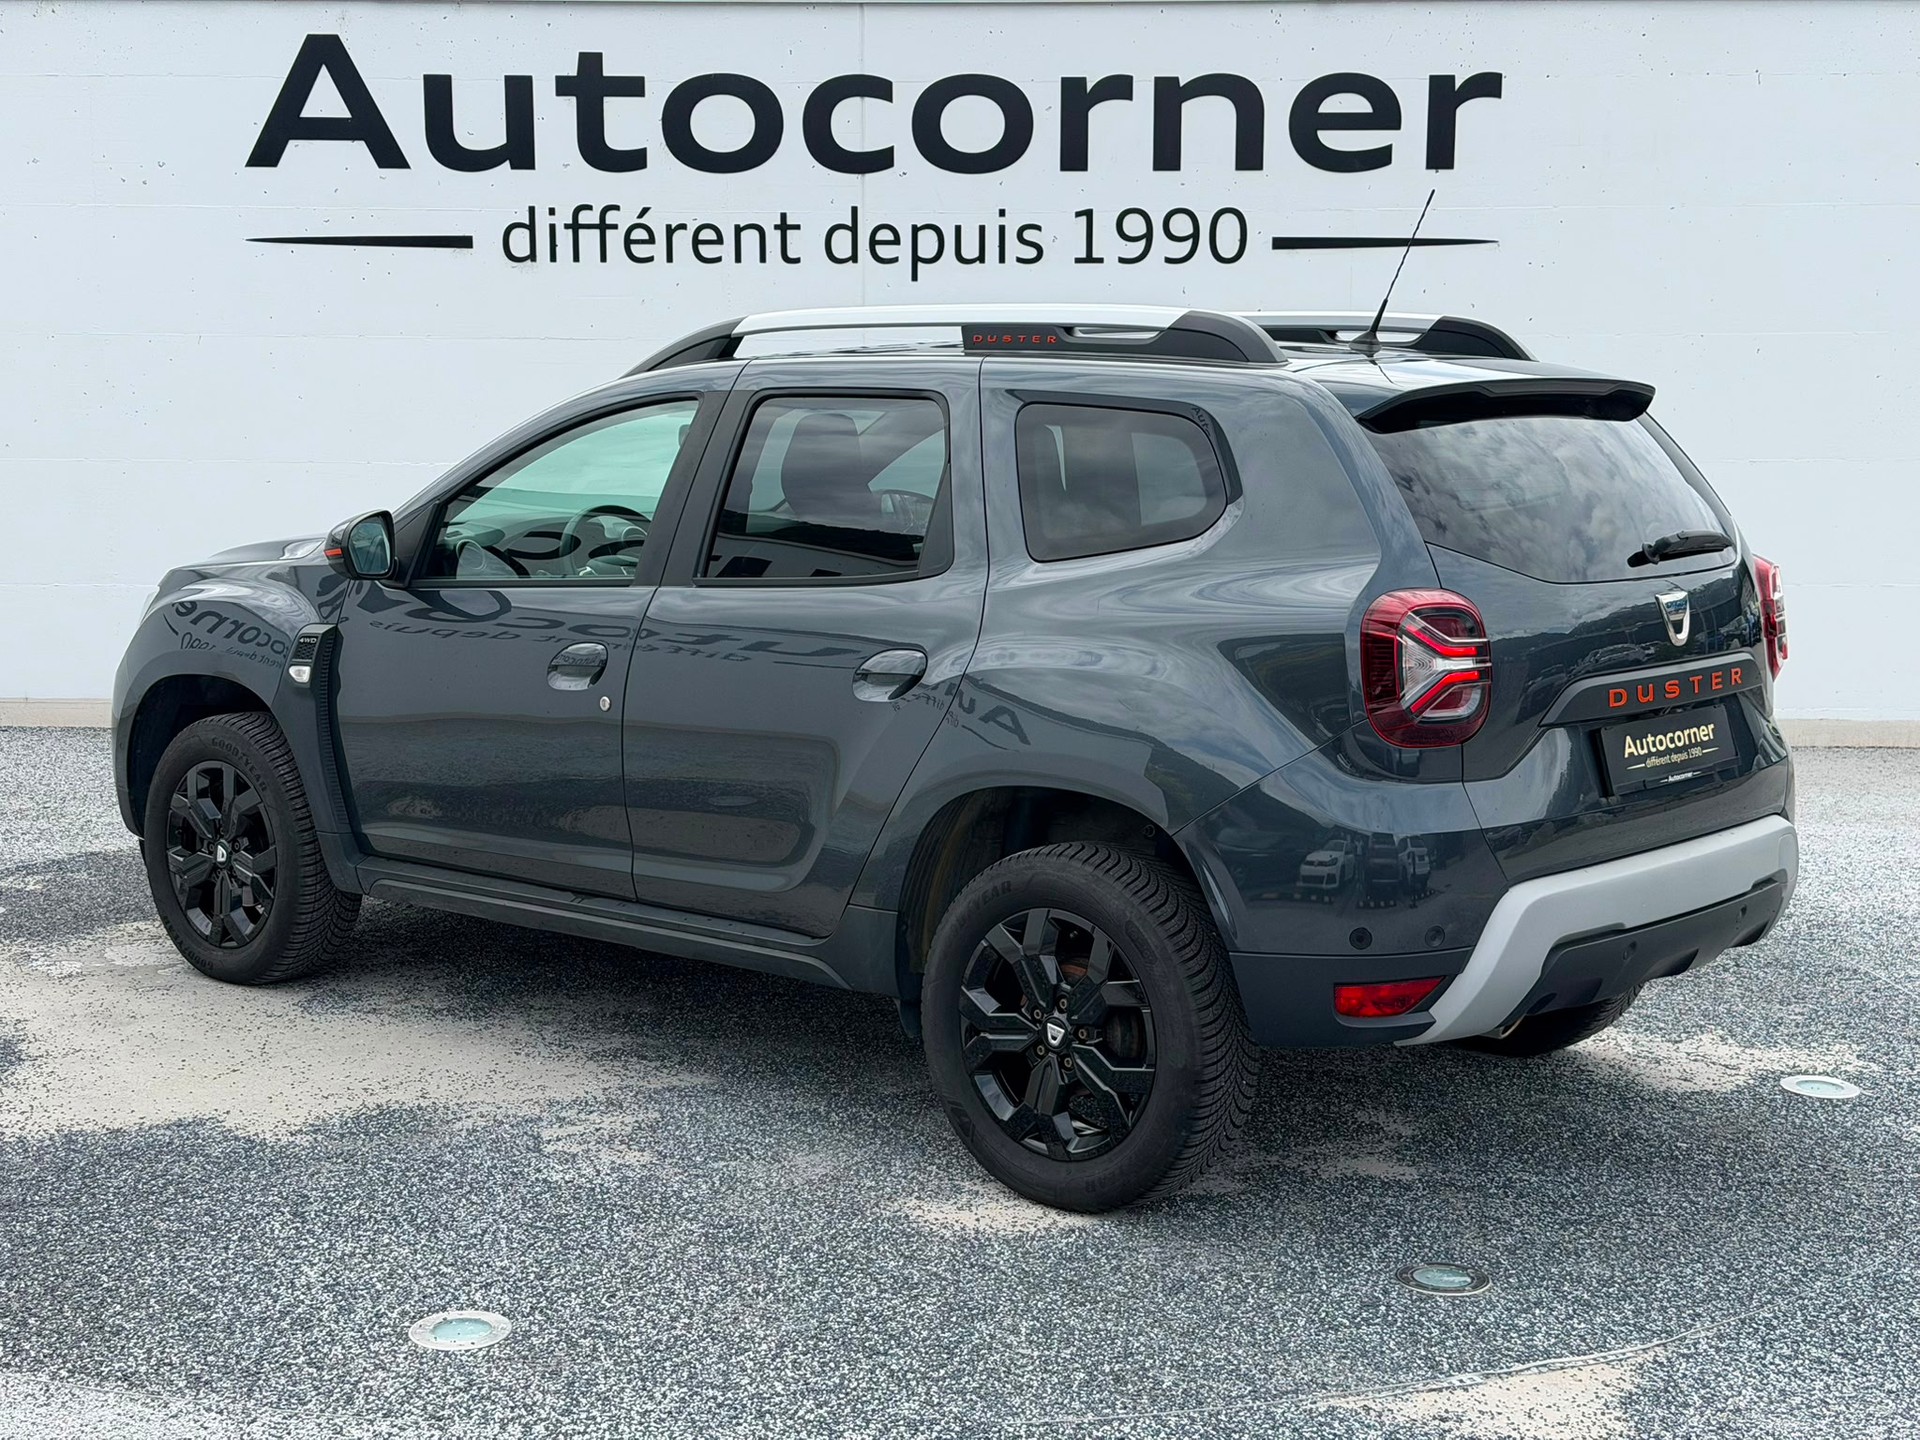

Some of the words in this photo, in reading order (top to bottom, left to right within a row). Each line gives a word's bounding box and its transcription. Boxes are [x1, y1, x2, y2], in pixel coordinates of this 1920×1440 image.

[245, 34, 1502, 174] Autocorner
[503, 204, 800, 264] différent
[825, 206, 1043, 281] depuis
[1075, 208, 1247, 264] 1990
[972, 334, 1058, 344] DUSTER
[1608, 667, 1743, 708] DUSTER
[1624, 723, 1715, 758] Autocorner
[1671, 750, 1688, 763] depuis
[1688, 746, 1703, 759] 1990
[211, 736, 267, 792] GOODYEAR
